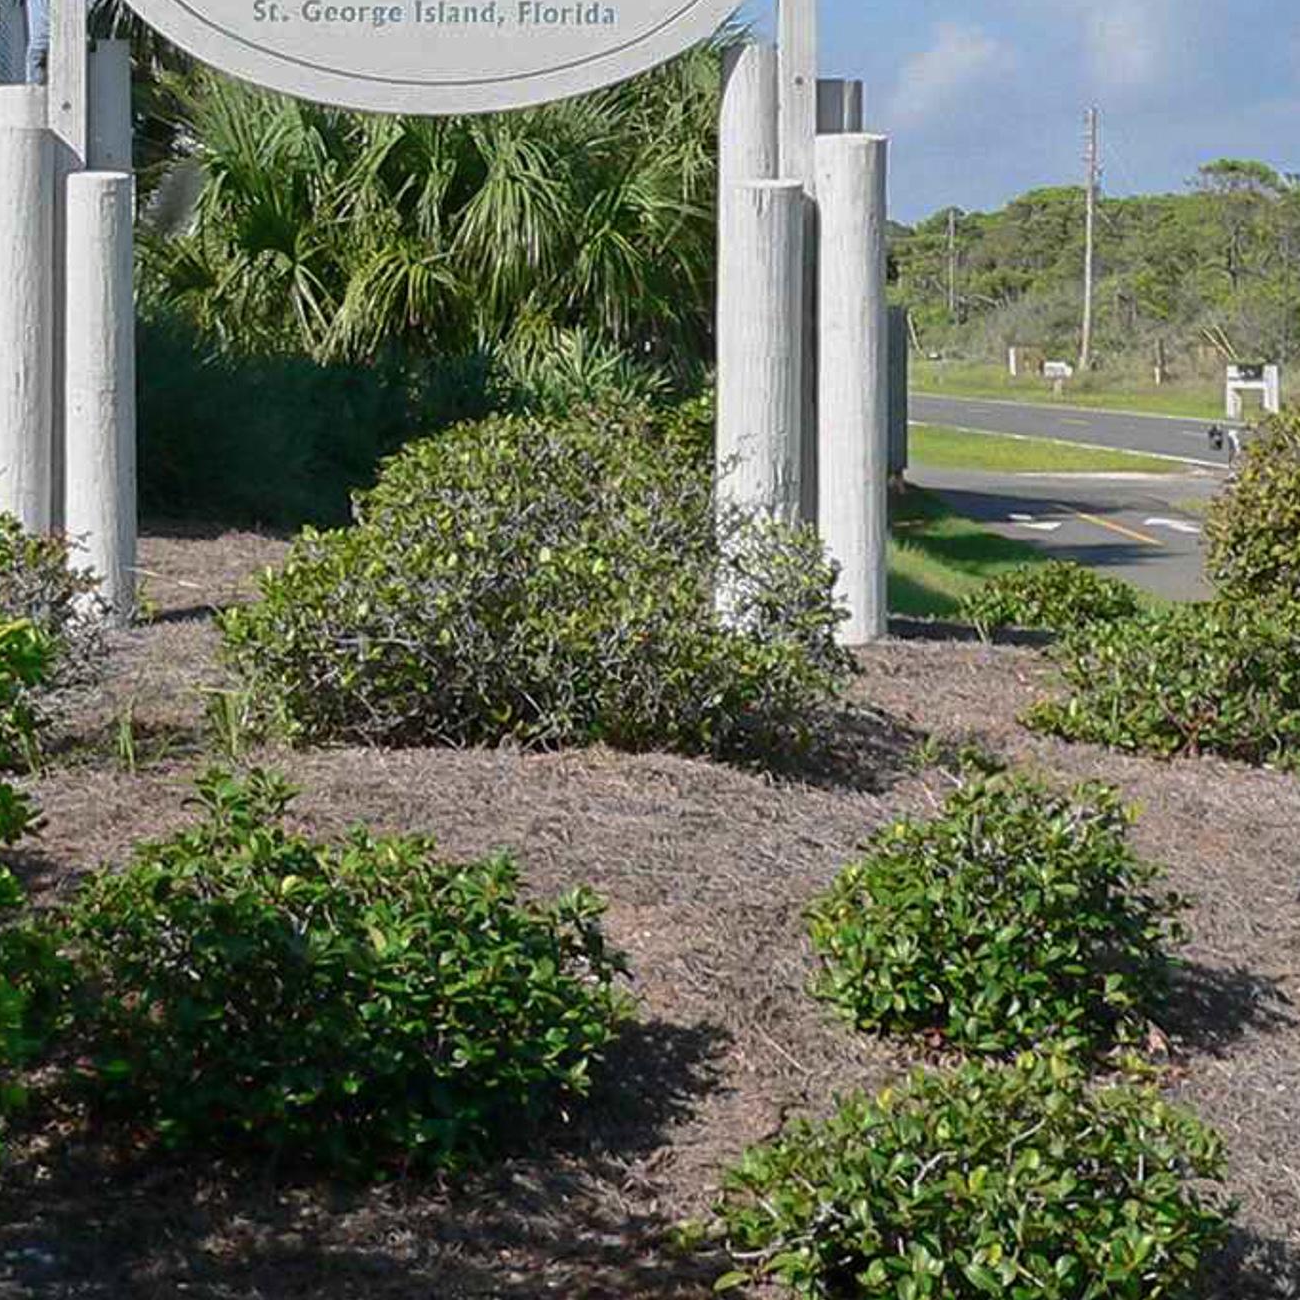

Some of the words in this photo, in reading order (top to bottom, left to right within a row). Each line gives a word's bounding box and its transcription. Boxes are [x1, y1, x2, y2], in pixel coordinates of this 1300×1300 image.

[252, 0, 292, 24] St.
[301, 0, 402, 27] George
[414, 0, 504, 27] Island,
[517, 0, 616, 26] Florida
